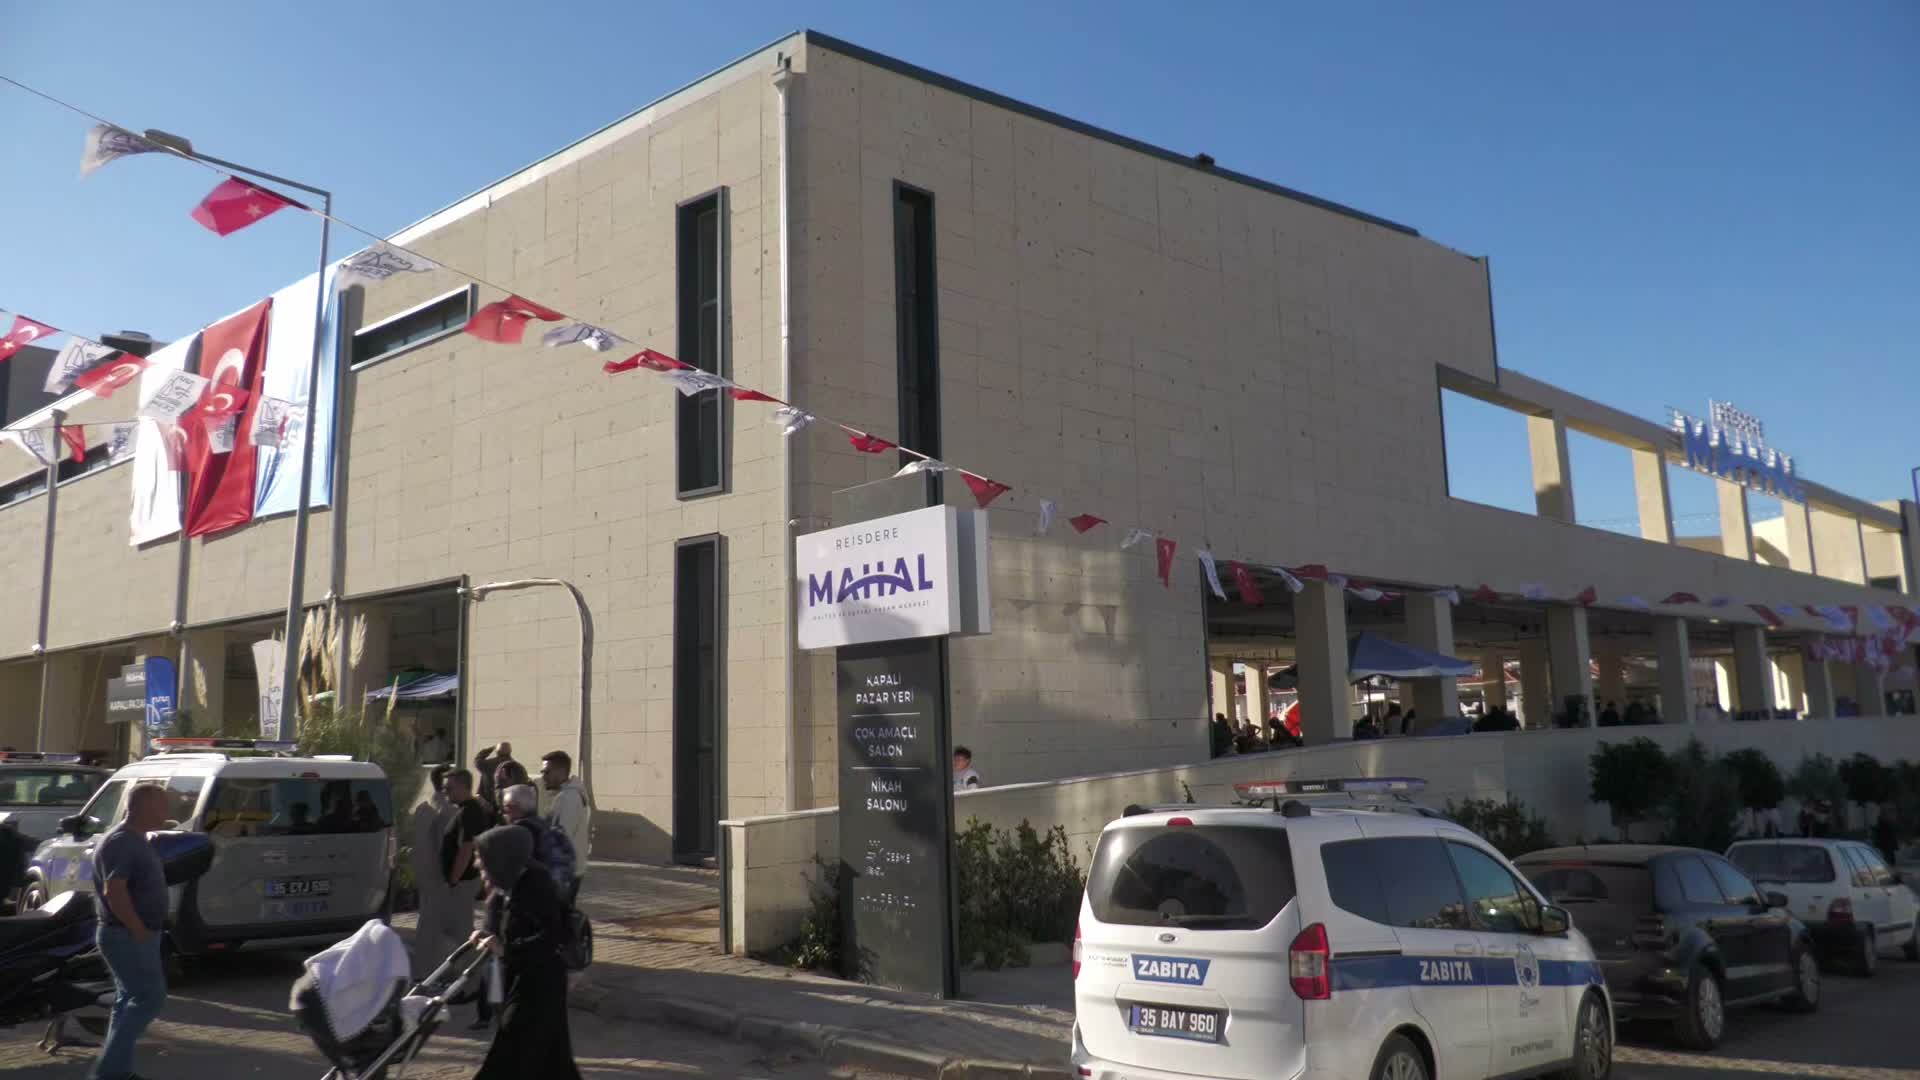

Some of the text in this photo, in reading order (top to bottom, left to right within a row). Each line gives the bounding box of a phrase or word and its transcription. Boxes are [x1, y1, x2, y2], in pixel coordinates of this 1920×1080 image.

[808, 553, 934, 607] MAHAL
[866, 672, 902, 687] KAPALI
[856, 691, 889, 704] PAZAR
[878, 726, 917, 741] AMAÇLI
[868, 744, 903, 757] SALON
[866, 798, 908, 811] SALONU
[1137, 960, 1200, 980] ZABITA
[1419, 960, 1473, 981] ZABITA
[1140, 1008, 1215, 1034] 35 BAY 960
